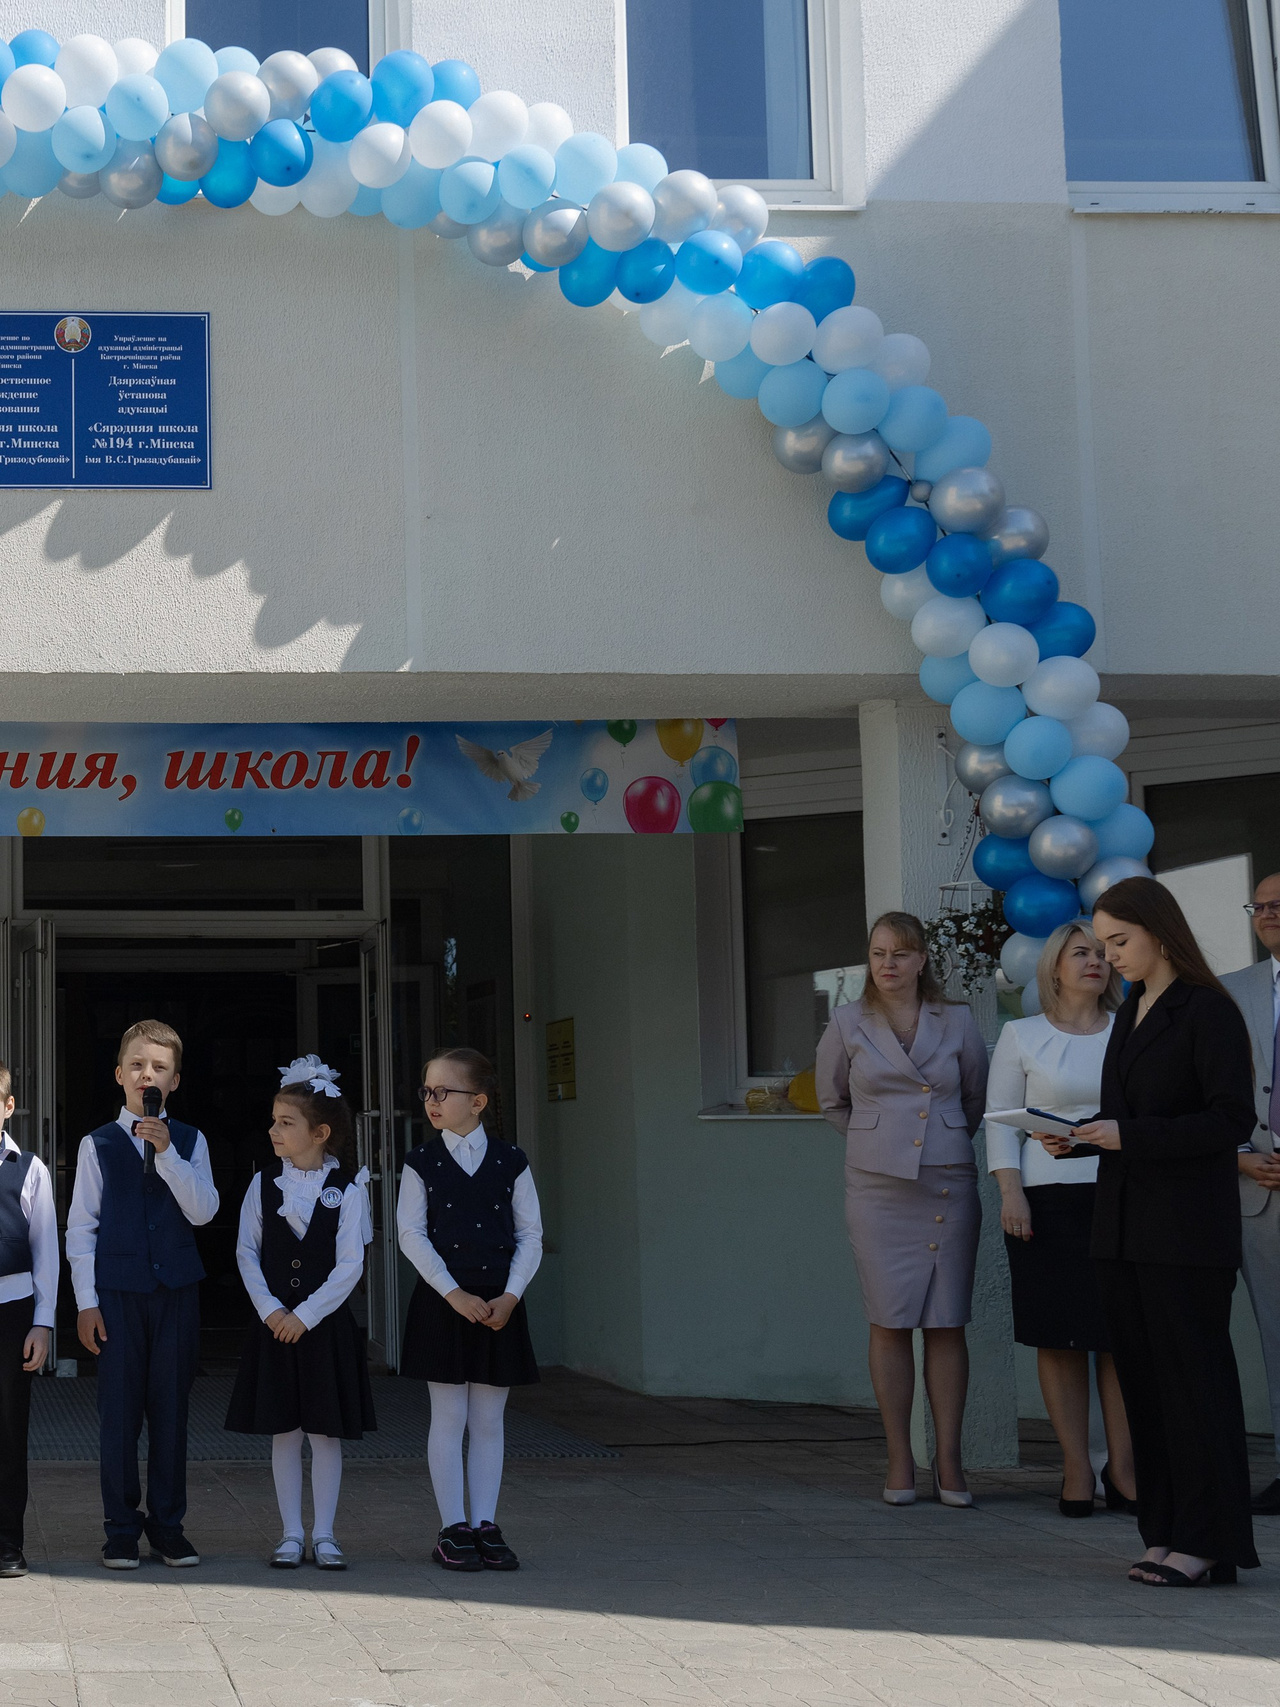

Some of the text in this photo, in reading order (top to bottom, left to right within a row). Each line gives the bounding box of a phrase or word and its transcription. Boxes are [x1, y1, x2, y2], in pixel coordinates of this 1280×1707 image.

[108, 376, 176, 388] Дзяржаўная
[118, 390, 167, 401] ўстанова
[118, 404, 168, 416] адукацыі
[18, 424, 58, 432] школа
[88, 422, 198, 435] «Сярэдняя школа
[0, 438, 60, 448] г.Минска
[92, 438, 195, 449] №194 г.Мінска
[85, 456, 101, 464] імя
[163, 735, 421, 791] школа!
